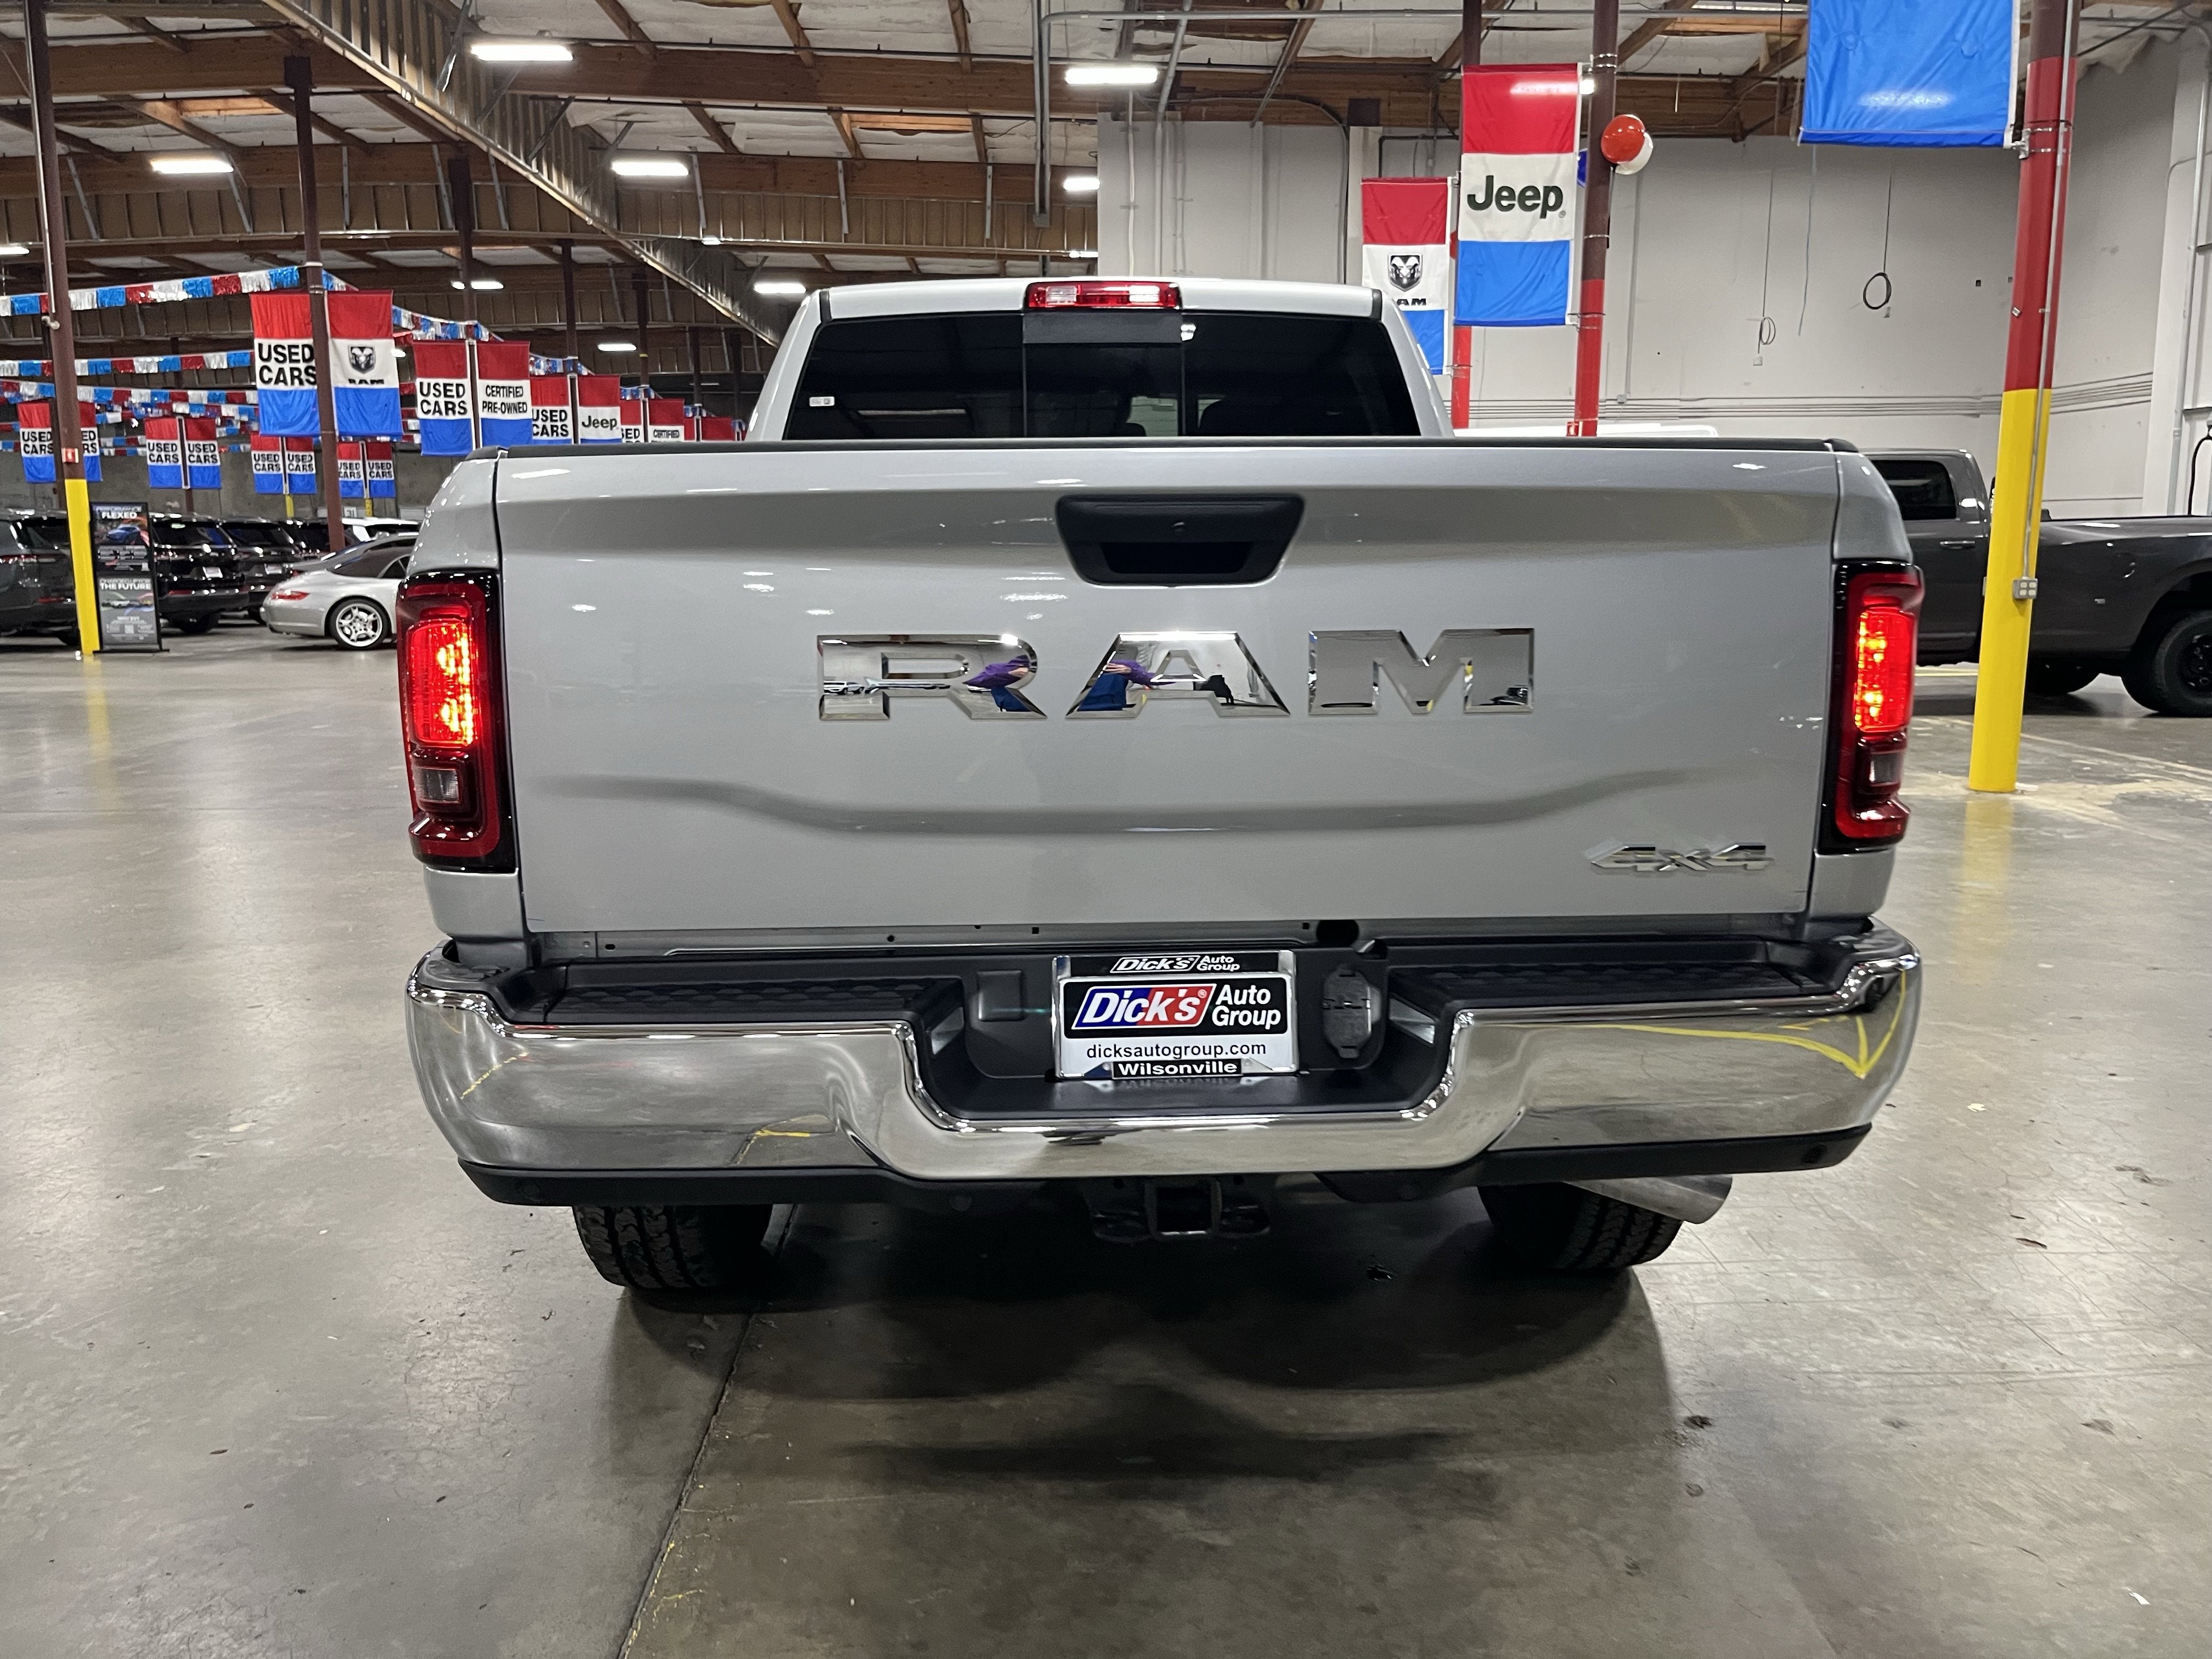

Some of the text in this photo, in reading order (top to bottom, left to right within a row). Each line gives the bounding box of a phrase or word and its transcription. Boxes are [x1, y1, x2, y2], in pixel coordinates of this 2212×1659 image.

[1467, 175, 1563, 219] Jeep
[258, 343, 314, 364] USED
[259, 365, 317, 386] CARS
[419, 382, 465, 398] USED
[486, 385, 523, 398] CERTIFIED
[420, 399, 467, 416] CARS
[482, 401, 527, 414] PRE-OWNED
[532, 409, 567, 422] USED
[582, 415, 617, 431] Jeep
[533, 424, 569, 437] CARS
[148, 442, 177, 452] USED
[188, 443, 216, 453] USED
[149, 453, 179, 463] CARS
[188, 454, 218, 464] CARS
[253, 453, 280, 462] USED
[287, 453, 313, 462] USED
[254, 463, 280, 471] CARS
[288, 463, 313, 472] CARS
[817, 628, 1534, 720] RAM
[1116, 957, 1190, 970] Dick's
[1197, 963, 1240, 972] Group
[1216, 984, 1271, 1006] Auto
[1082, 989, 1200, 1023] Dick's
[1212, 1005, 1281, 1030] Group
[1087, 1044, 1266, 1059] dicksautogroup.com
[1118, 1061, 1237, 1076] Wilsonville
